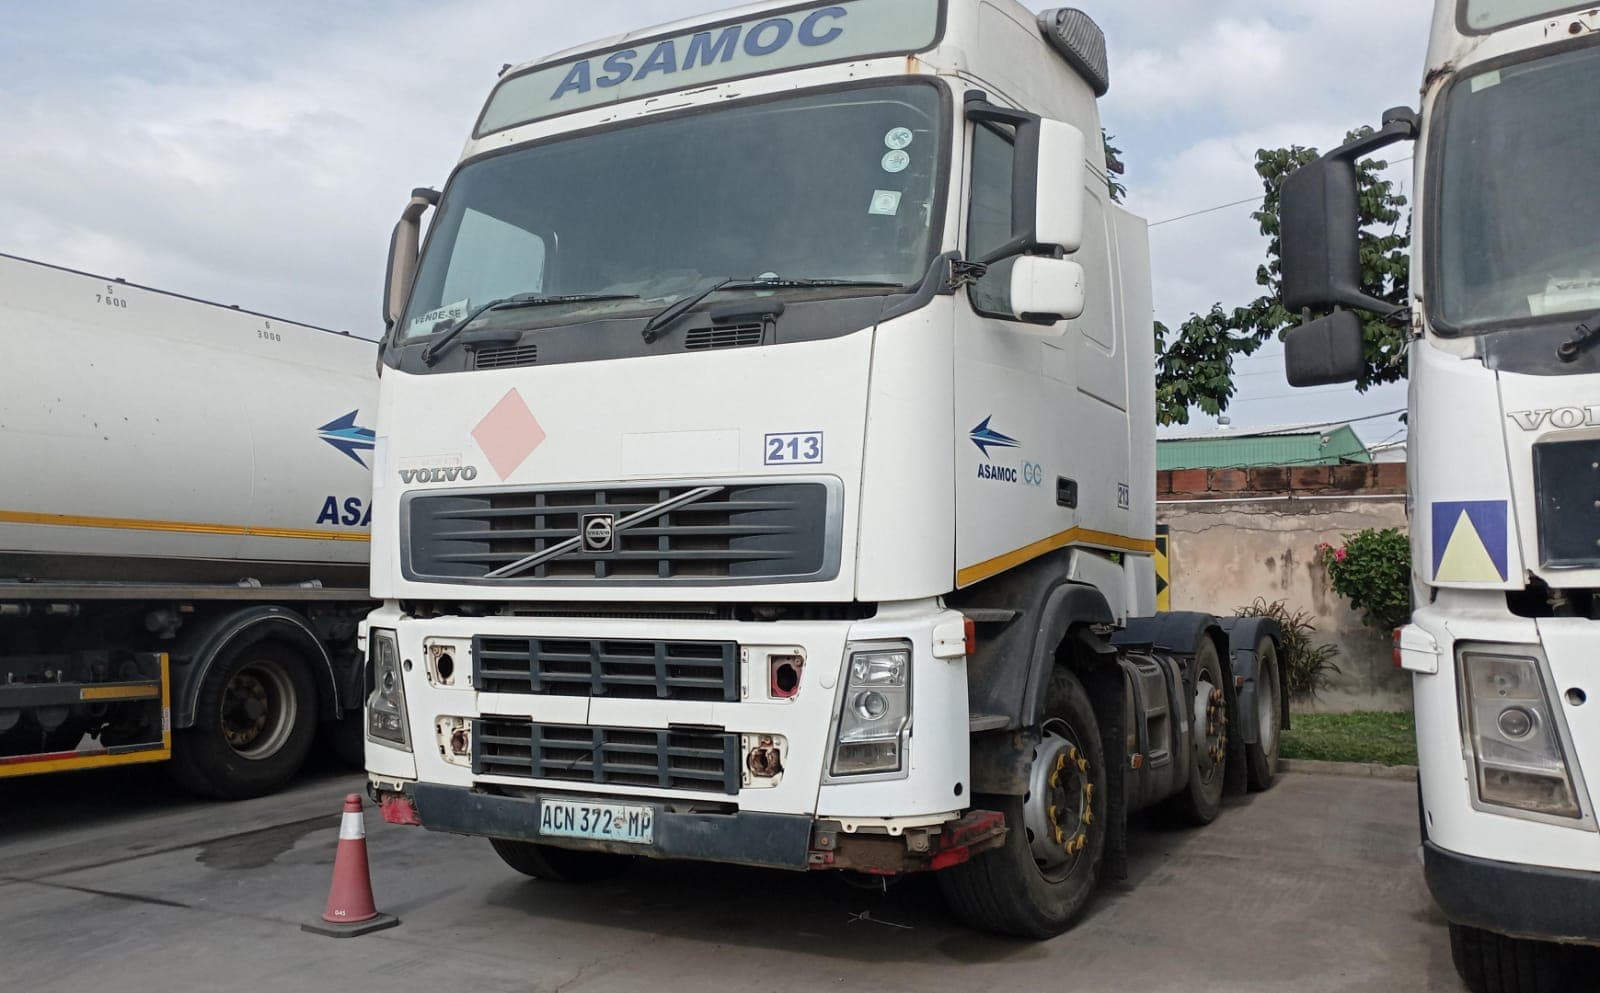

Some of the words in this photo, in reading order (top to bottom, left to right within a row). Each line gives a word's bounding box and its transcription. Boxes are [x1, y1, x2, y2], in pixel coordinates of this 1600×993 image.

[549, 6, 848, 101] ASAMOC
[767, 436, 820, 461] 213
[398, 465, 478, 485] VOLVO
[977, 463, 1018, 483] ASAMOC
[542, 805, 575, 832] ACN
[580, 807, 613, 835] 372
[628, 811, 651, 838] MP
